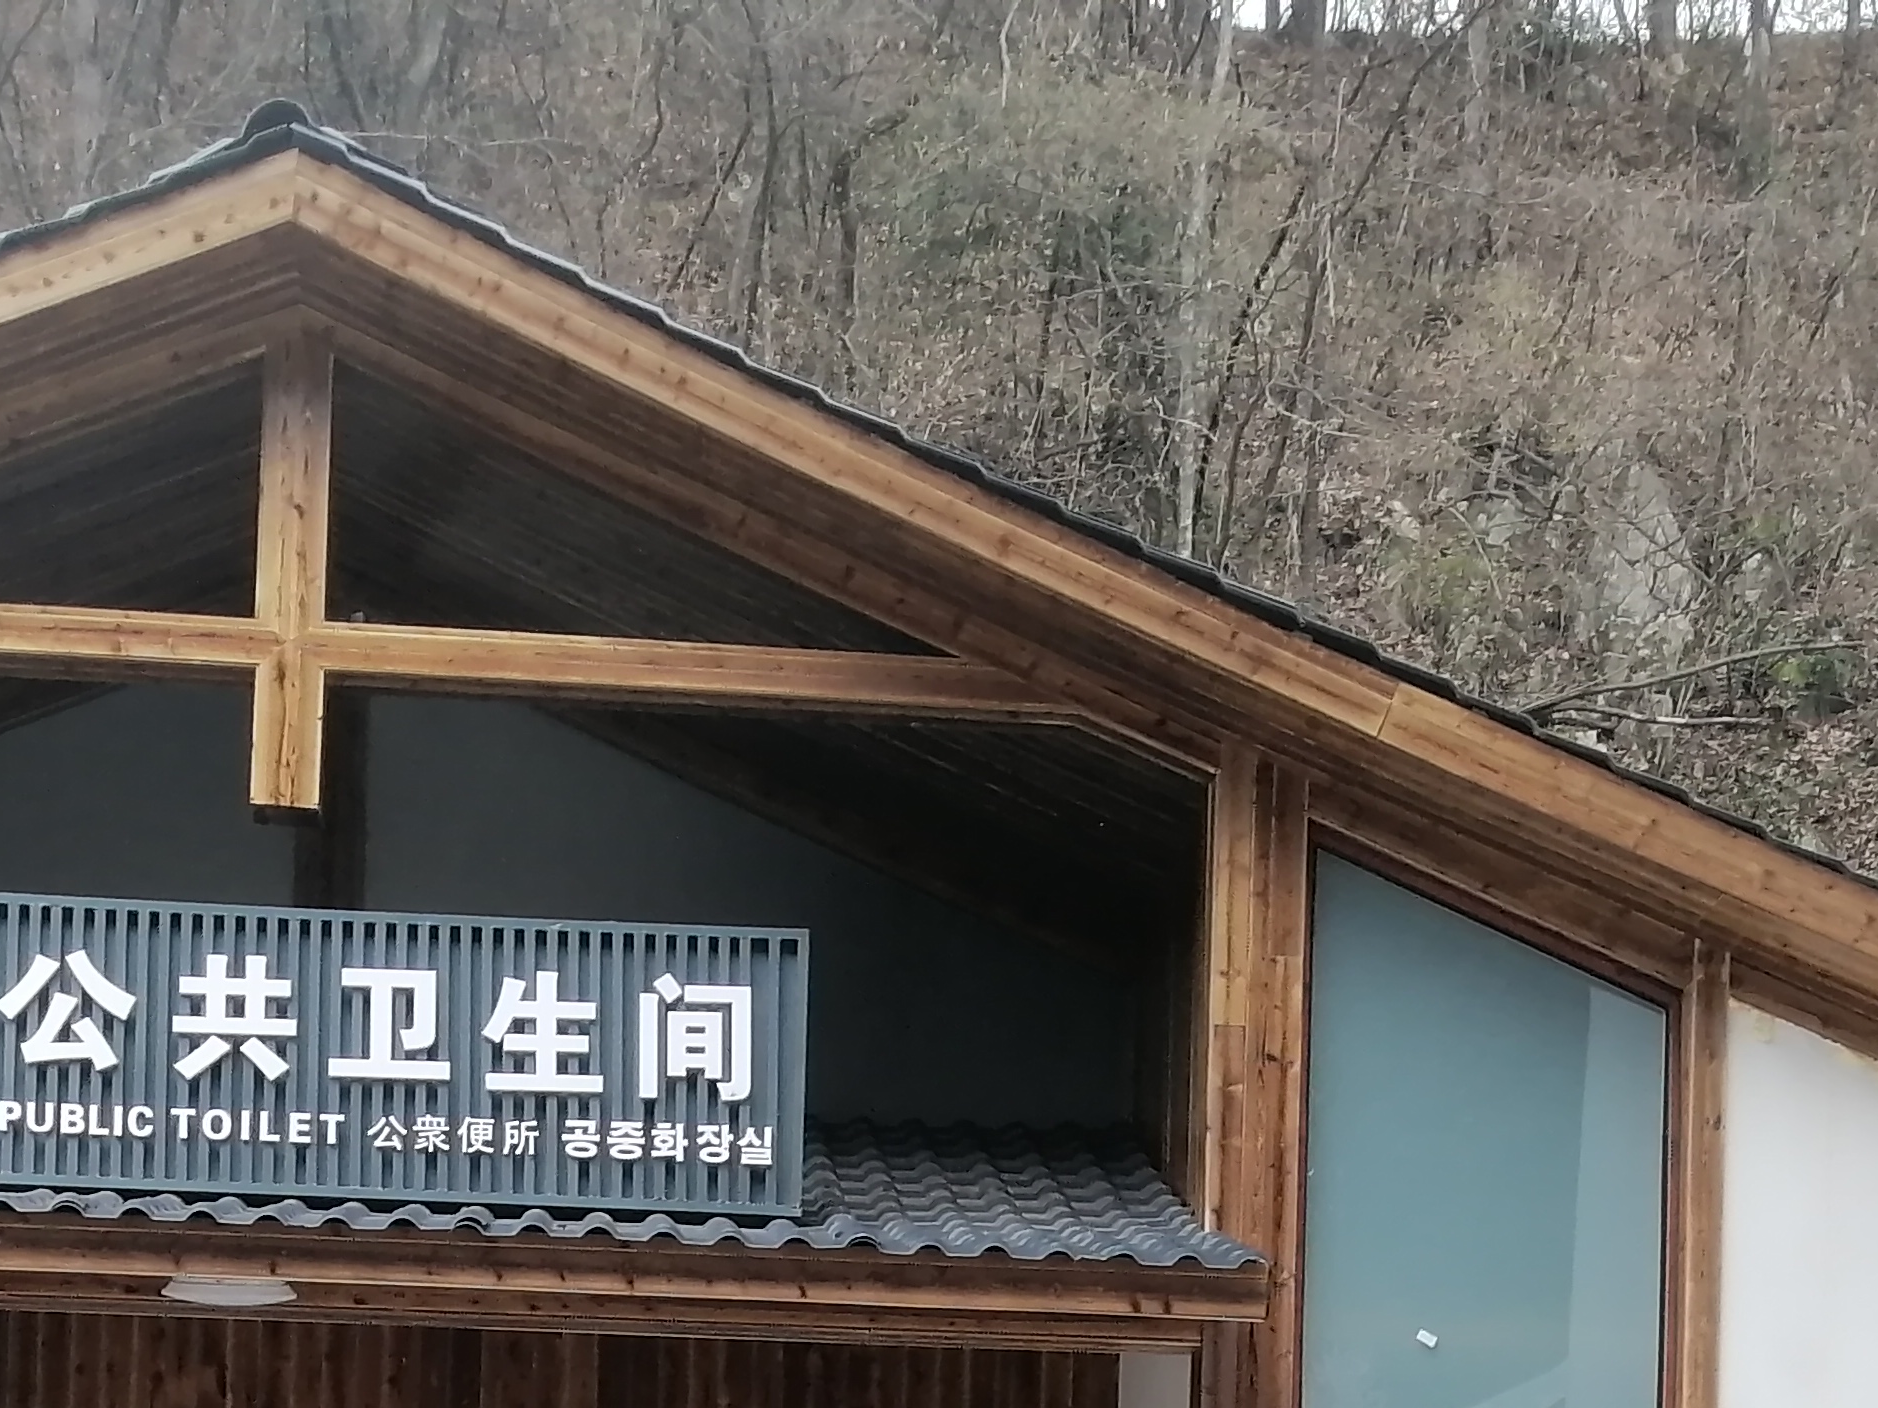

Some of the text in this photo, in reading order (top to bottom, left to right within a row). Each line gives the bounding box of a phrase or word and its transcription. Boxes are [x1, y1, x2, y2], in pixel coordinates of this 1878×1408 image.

[169, 1106, 347, 1146] TOILET
[366, 1113, 541, 1156] 公衆便所
[561, 1119, 775, 1166] 공중화장실
